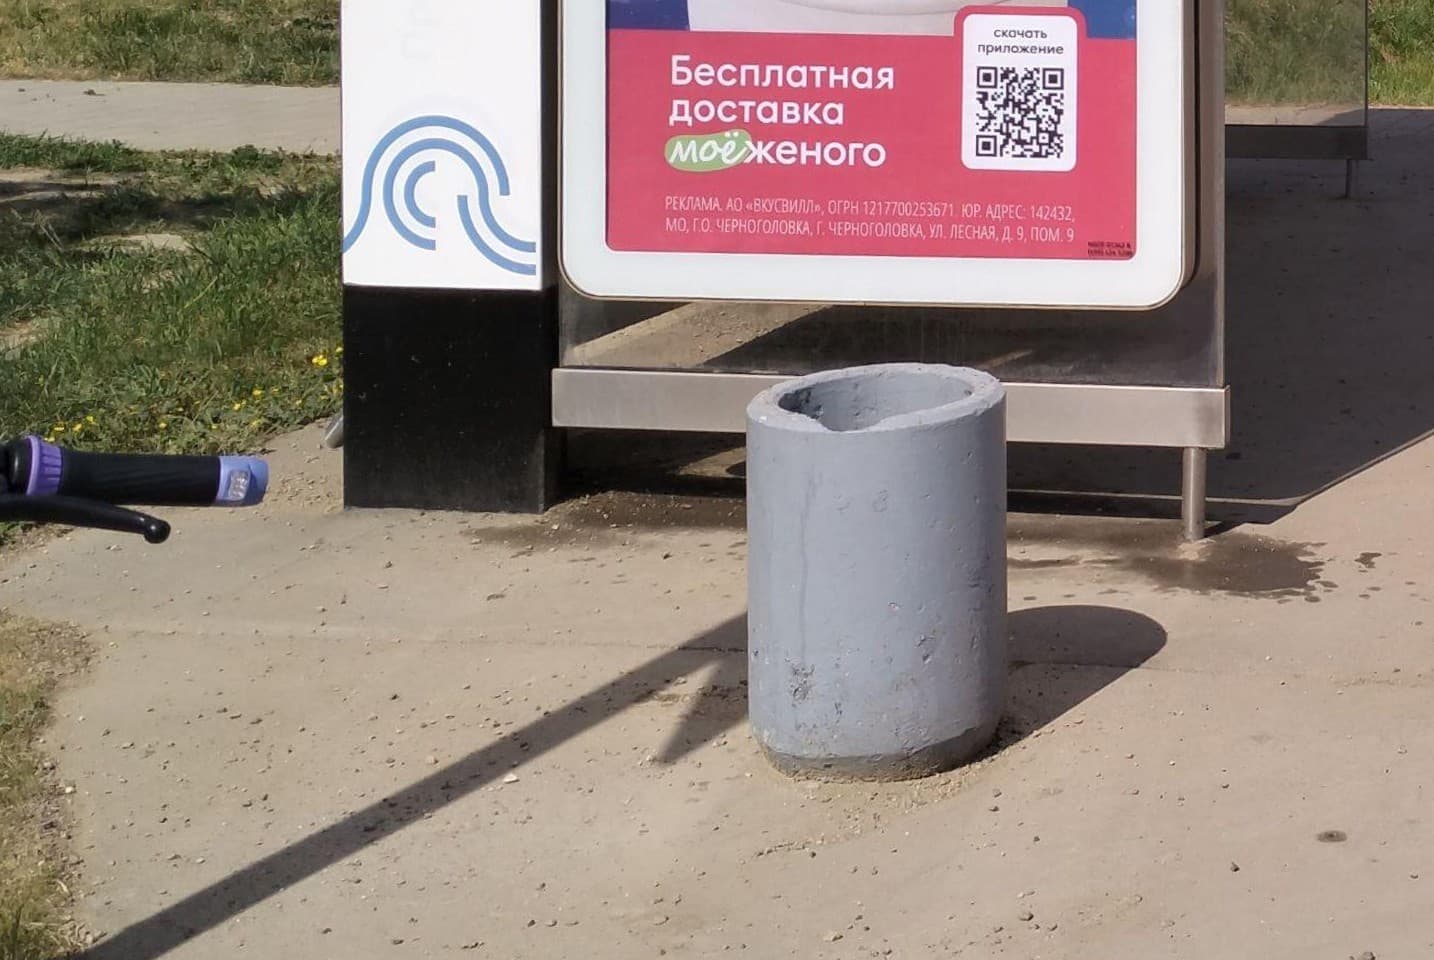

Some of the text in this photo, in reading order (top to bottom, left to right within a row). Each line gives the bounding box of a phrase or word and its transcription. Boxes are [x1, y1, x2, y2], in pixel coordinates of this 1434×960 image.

[993, 28, 1048, 39] скачать
[977, 43, 1064, 56] приложение
[671, 54, 895, 89] Бесплатная
[668, 99, 844, 127] доставка
[665, 196, 722, 212] РЕКЛАМА.
[726, 199, 743, 212] АО
[745, 198, 825, 216] «ВКУСВИЛЛ»,
[828, 200, 859, 215] ОГРН
[961, 204, 982, 218] ЮР.
[985, 204, 1027, 222] АДРЕС:
[1030, 205, 1075, 223] 142432,
[665, 217, 1075, 243] МО, Г.О. ЧЕРНОГОЛОВКА, Г. ЧЕРНОГОЛОВКА, УЛ. ЛЕСНАЯ, Д. 9, ПОМ. 9
